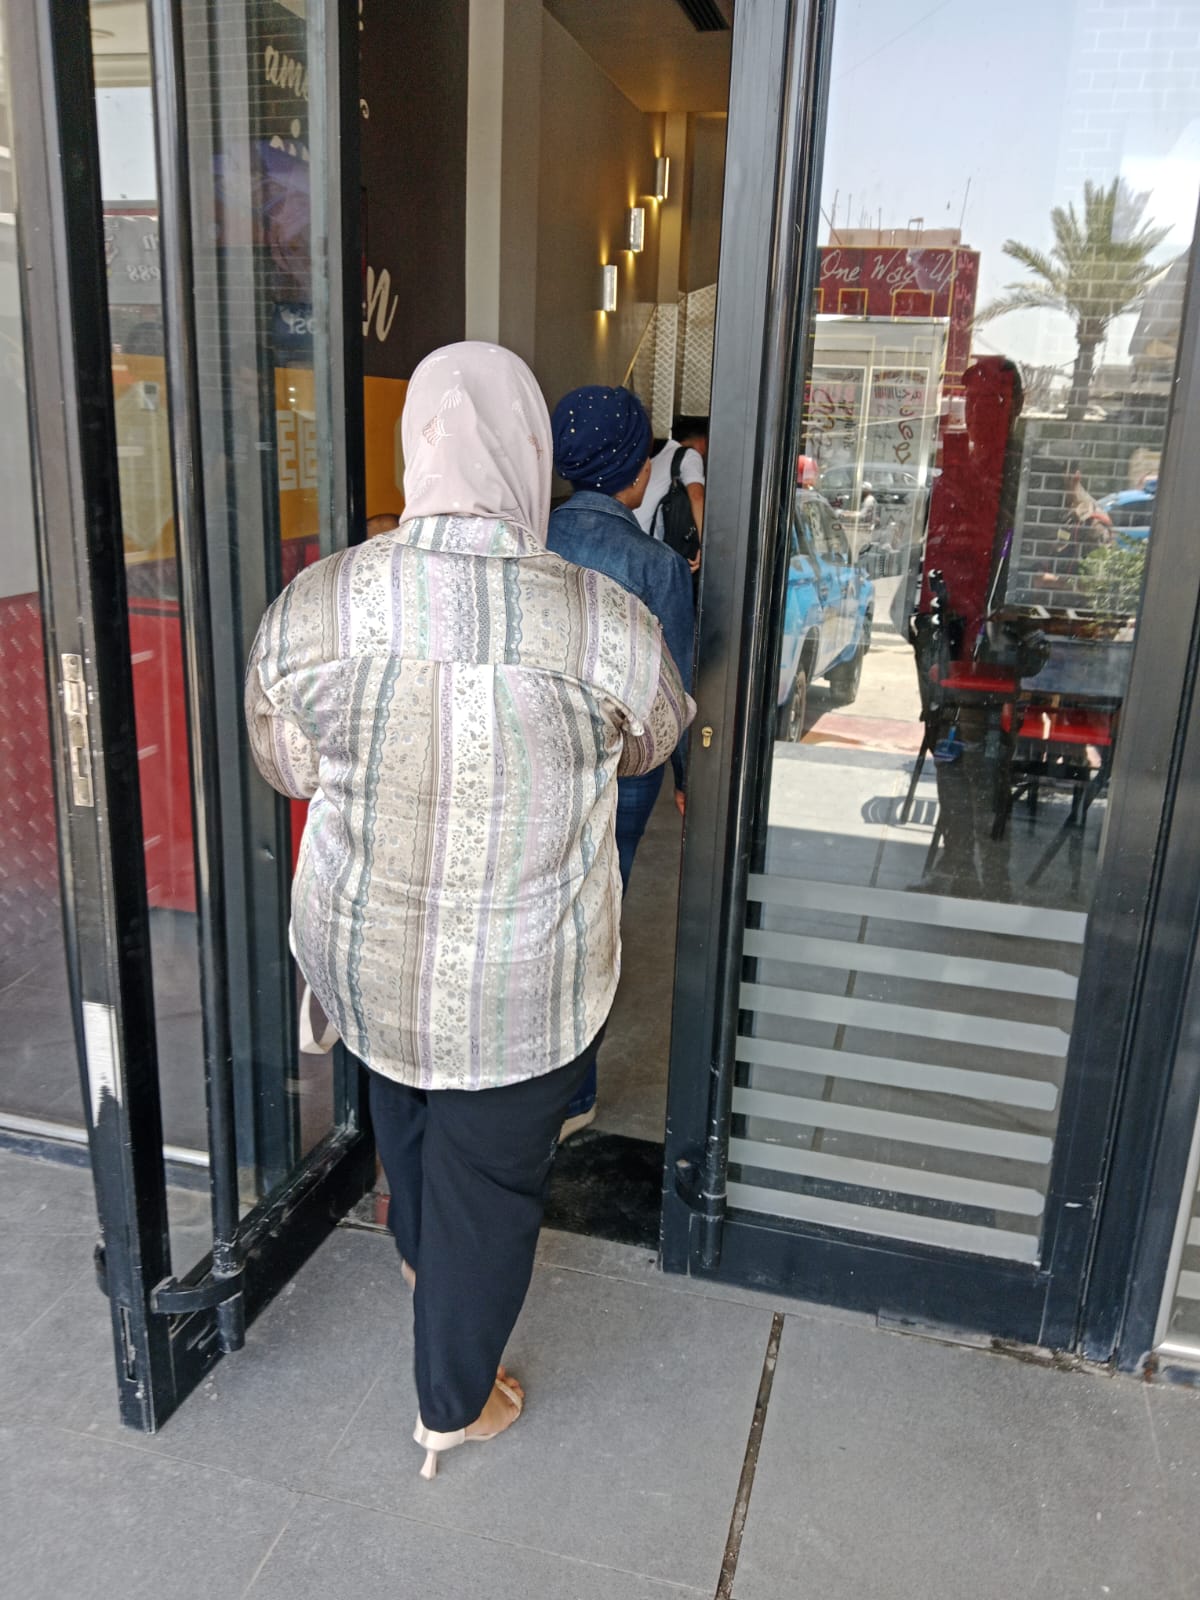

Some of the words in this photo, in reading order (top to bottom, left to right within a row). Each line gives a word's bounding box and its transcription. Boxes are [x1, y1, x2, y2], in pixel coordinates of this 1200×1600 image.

[820, 249, 860, 282] One
[871, 249, 919, 295] Way
[929, 251, 960, 294] Up
